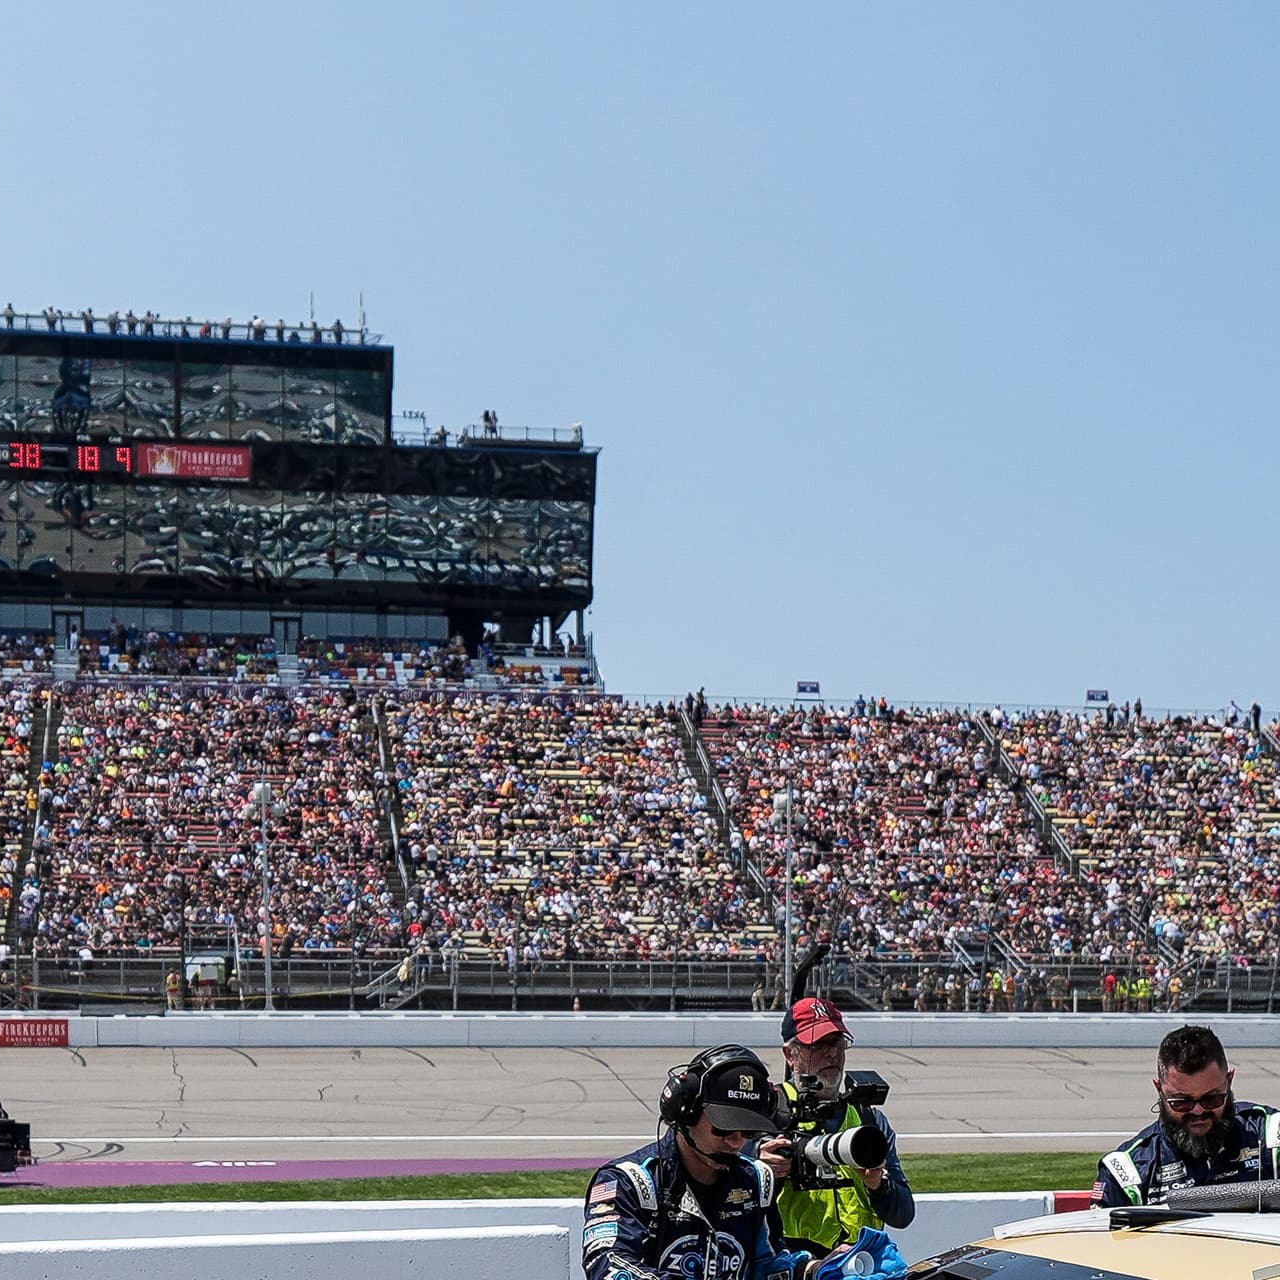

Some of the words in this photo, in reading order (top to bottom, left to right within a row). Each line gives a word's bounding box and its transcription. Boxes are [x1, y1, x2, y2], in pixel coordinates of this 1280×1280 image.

[9, 441, 42, 469] 38
[77, 446, 101, 472] 18
[116, 447, 132, 472] 9
[0, 1022, 66, 1037] FIREKEEPERS
